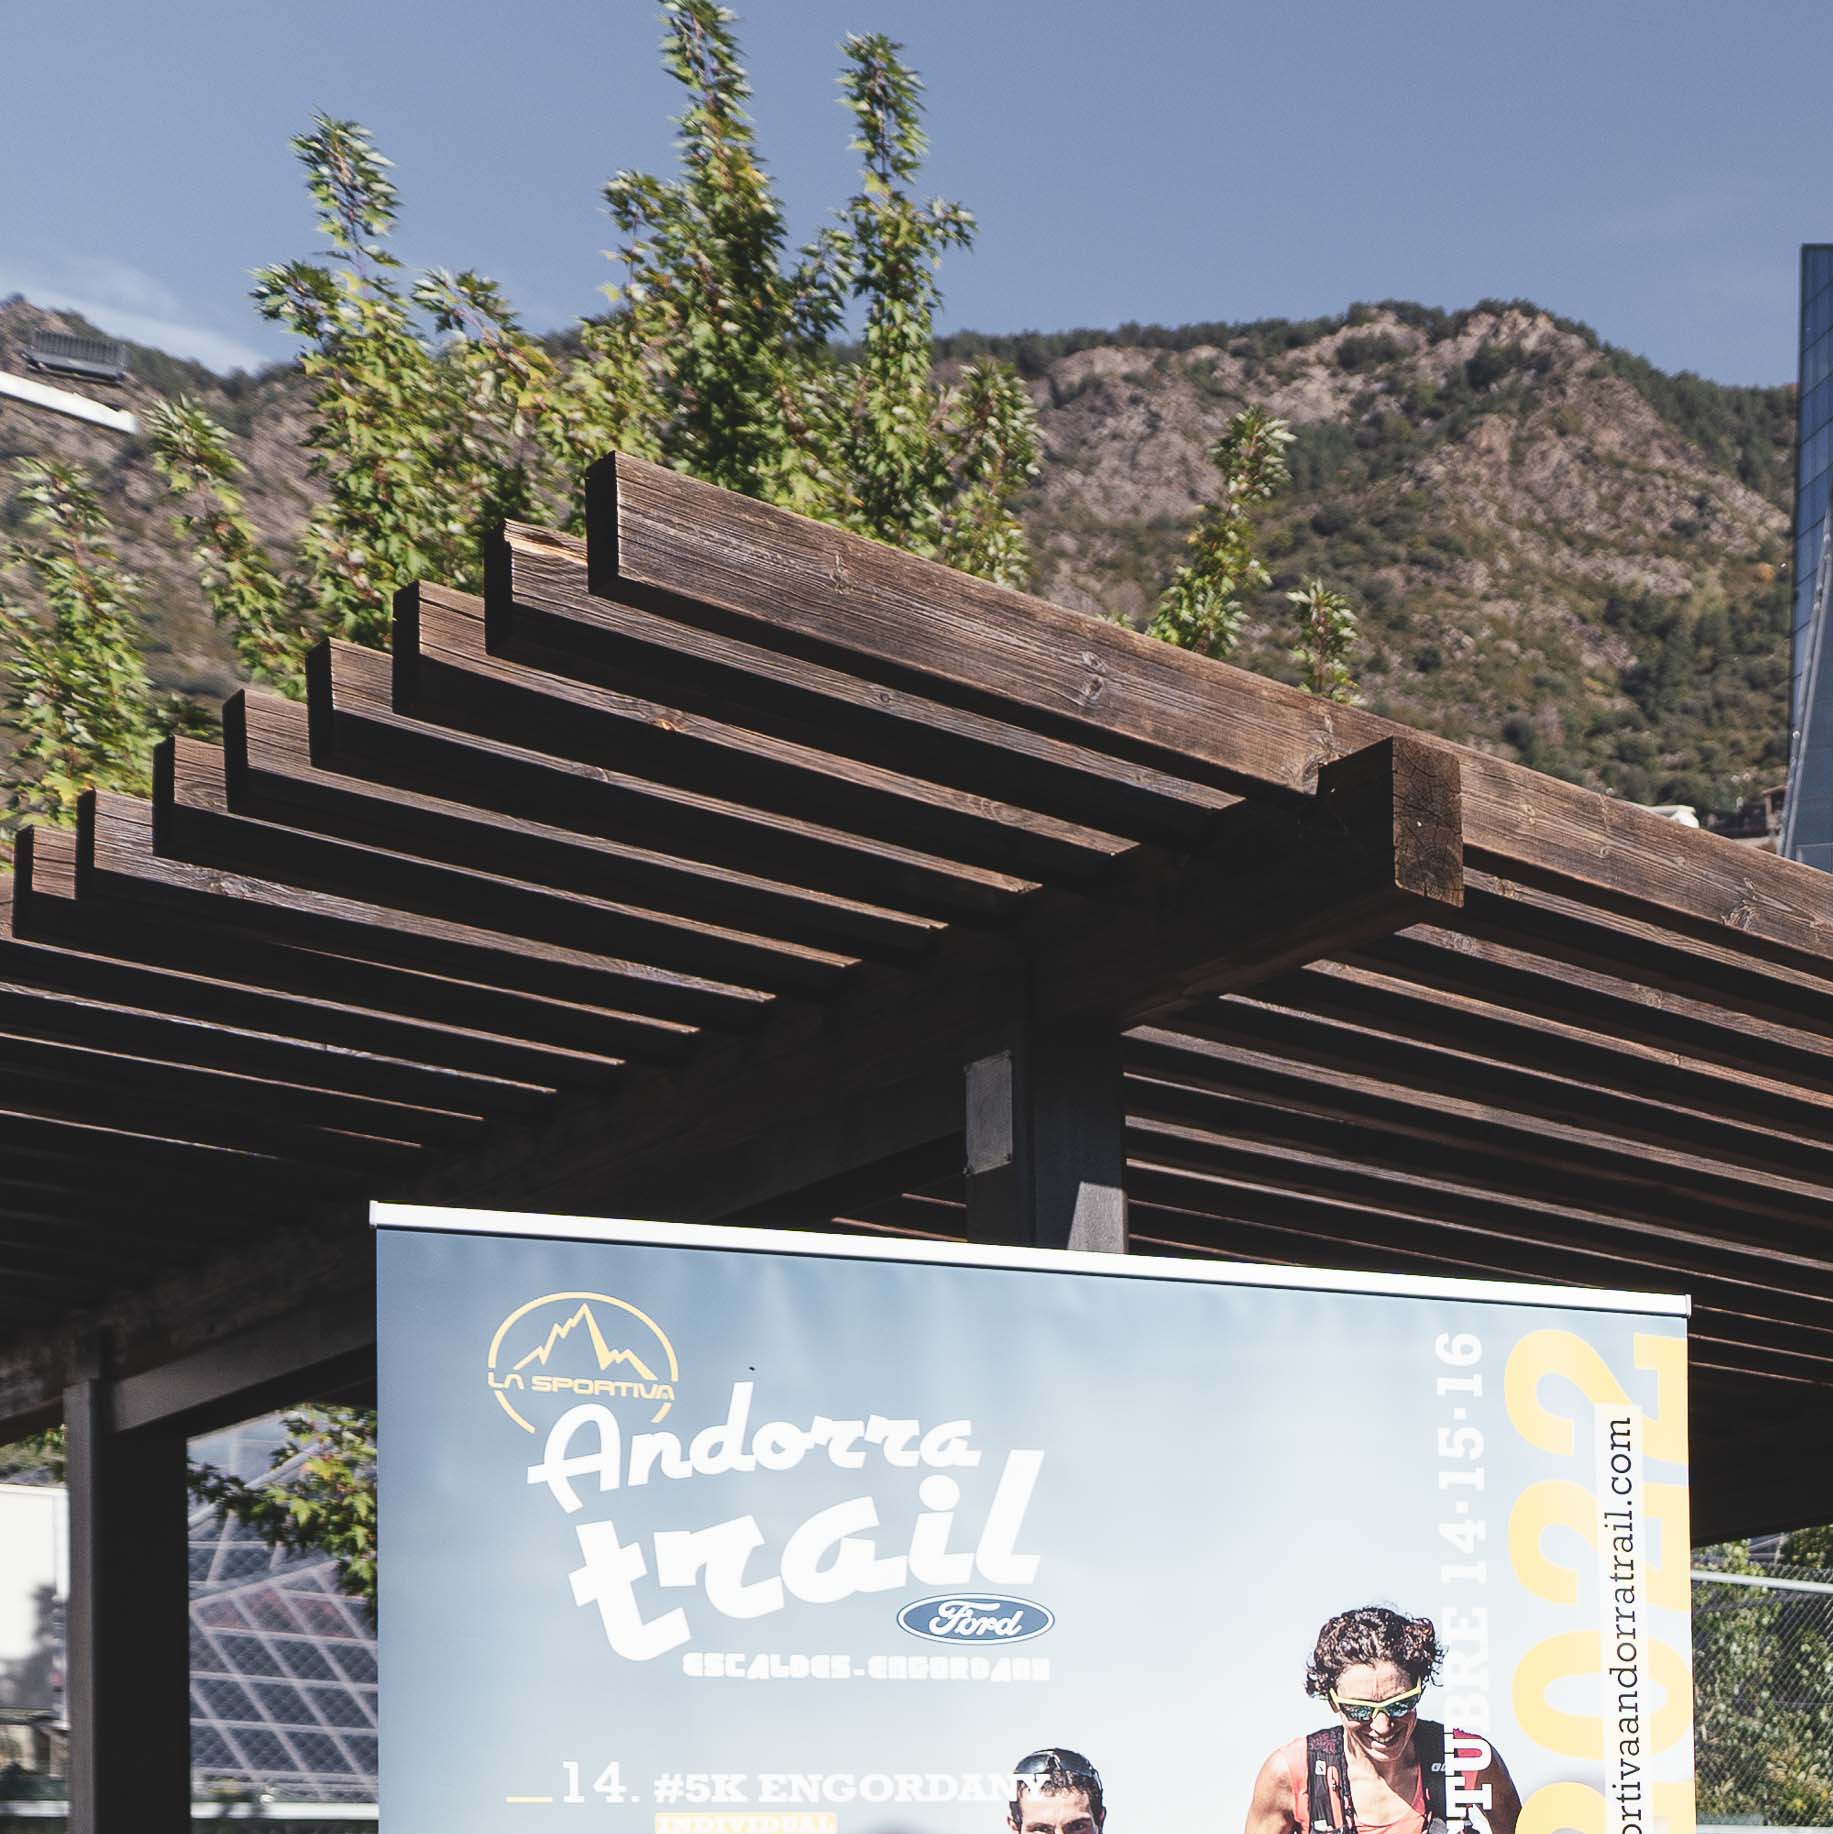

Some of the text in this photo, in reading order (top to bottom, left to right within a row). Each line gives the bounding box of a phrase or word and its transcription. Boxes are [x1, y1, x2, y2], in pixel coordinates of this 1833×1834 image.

[488, 1372, 676, 1400] LA SPORTIVA
[527, 1381, 982, 1514] Andorra
[568, 1448, 1046, 1662] trail
[927, 1597, 1027, 1639] Ford
[561, 1761, 1051, 1804] 14. #5K ENGORDANY
